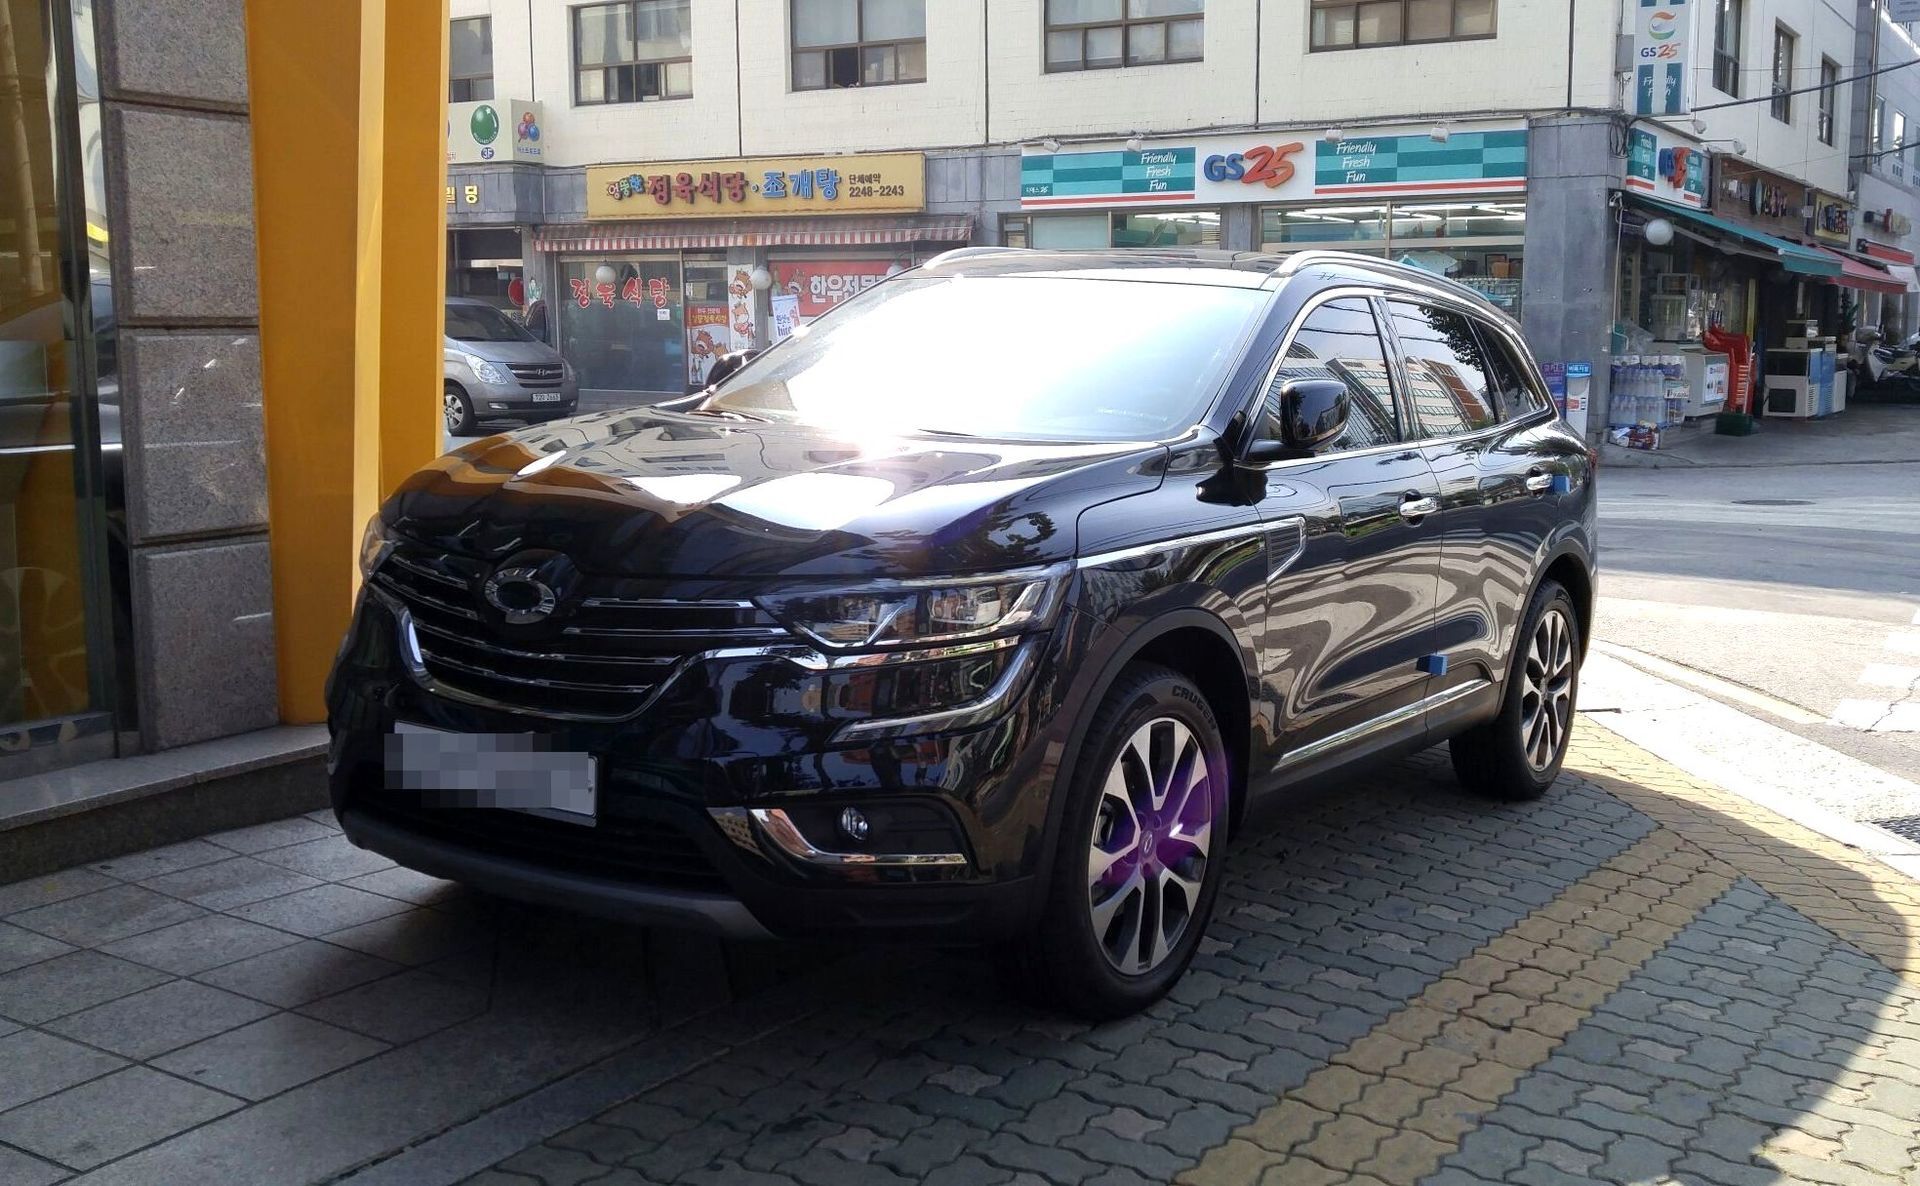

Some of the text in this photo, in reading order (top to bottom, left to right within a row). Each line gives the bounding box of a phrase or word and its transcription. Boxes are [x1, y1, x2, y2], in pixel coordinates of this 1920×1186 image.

[1641, 42, 1681, 59] GS25
[1336, 141, 1377, 156] Friendly
[1141, 151, 1177, 165] Friendly
[1342, 155, 1370, 169] Fresh
[1146, 164, 1171, 178] Fresh
[1203, 142, 1304, 189] GS25
[1345, 169, 1366, 183] Fun
[648, 171, 748, 205] 정육식당
[762, 168, 842, 201] 조개탕
[849, 185, 905, 198] 2248-2243
[1149, 179, 1167, 191] Fun
